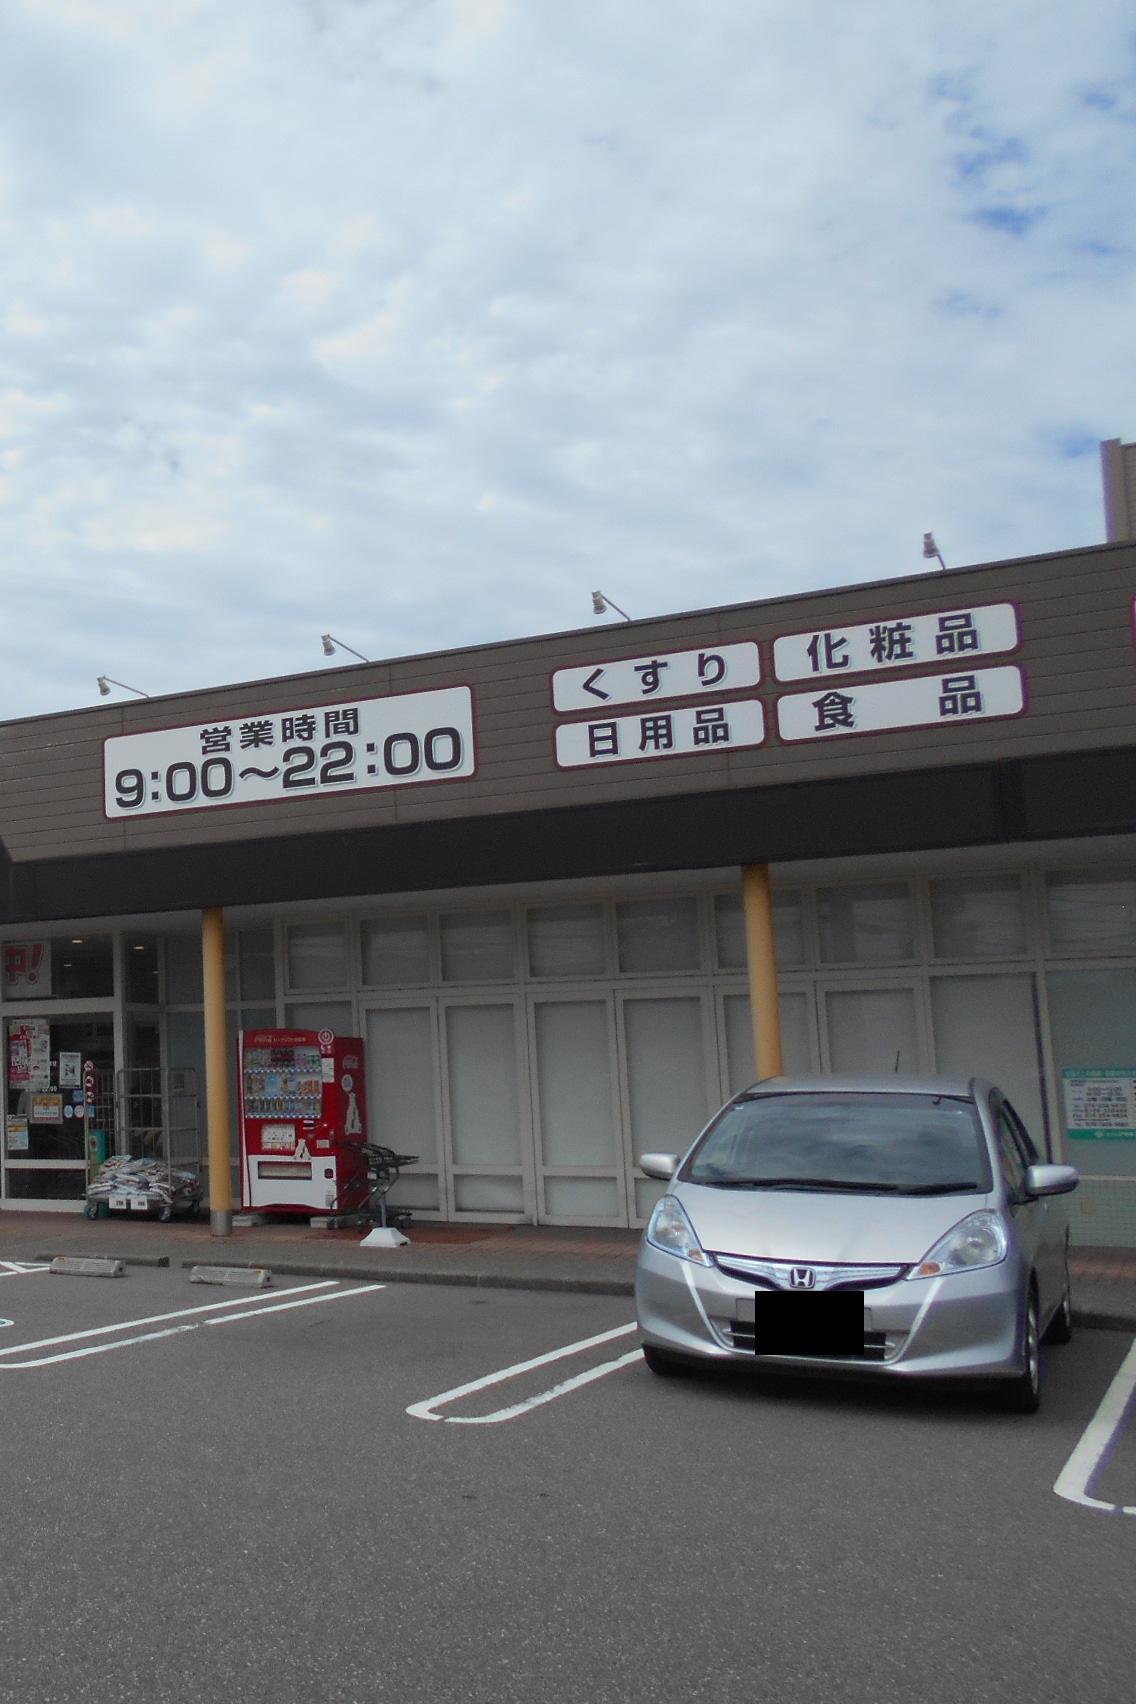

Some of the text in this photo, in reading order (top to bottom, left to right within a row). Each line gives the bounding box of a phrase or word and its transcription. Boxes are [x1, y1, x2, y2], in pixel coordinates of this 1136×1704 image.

[806, 612, 978, 673] 化粧品
[582, 652, 727, 700] くすり
[812, 675, 982, 732] 食品
[199, 707, 360, 755] 営業時間
[587, 706, 730, 758] 日用品
